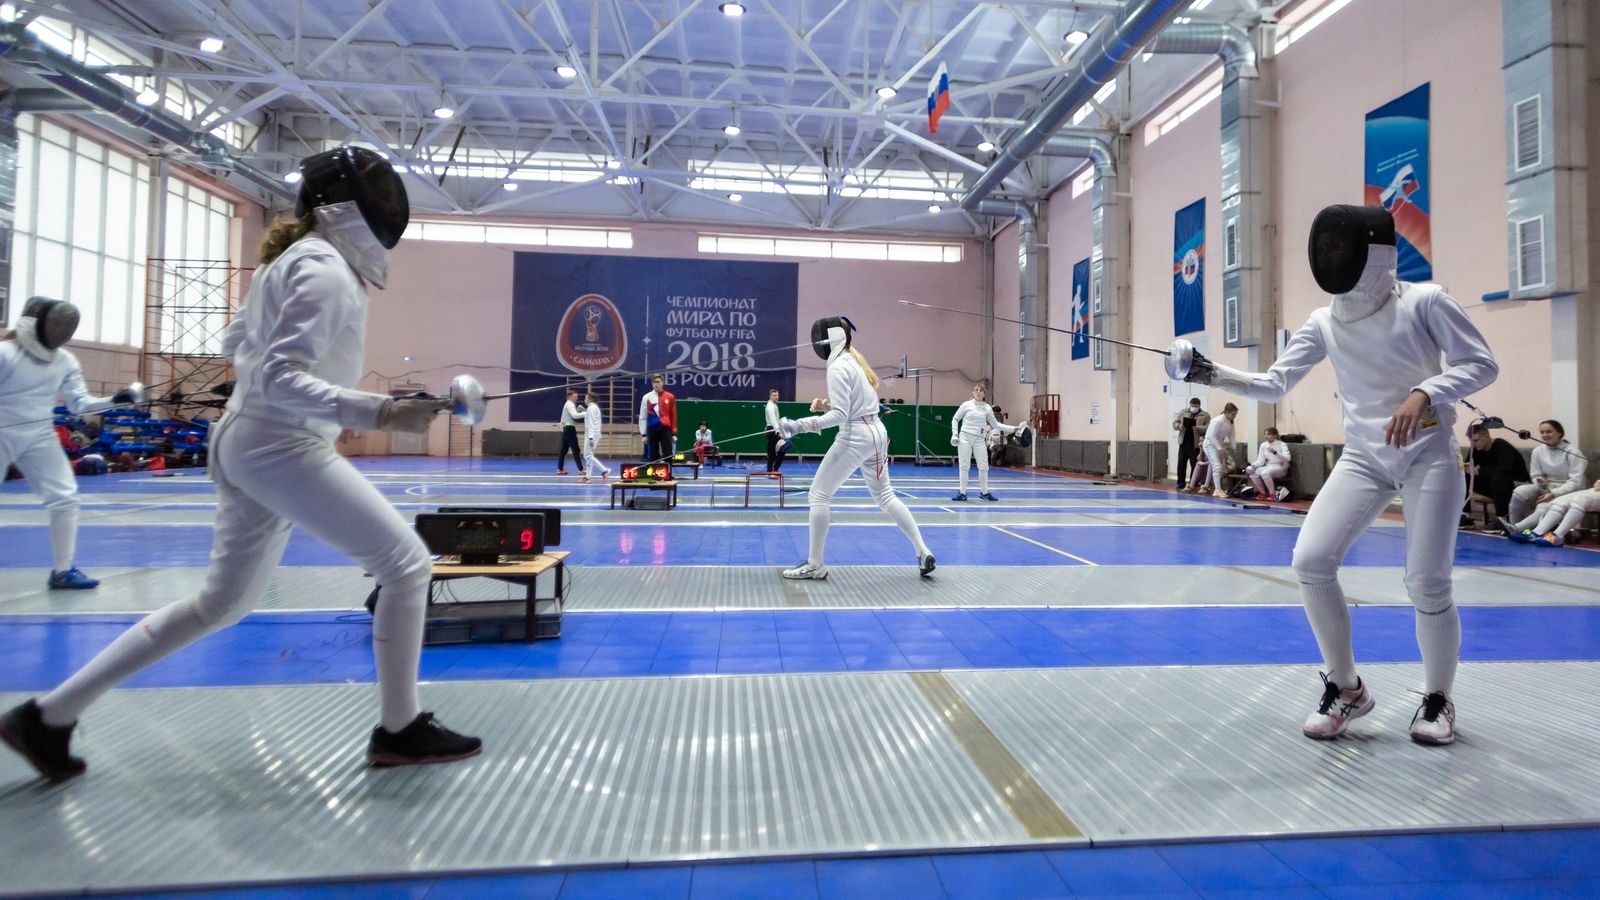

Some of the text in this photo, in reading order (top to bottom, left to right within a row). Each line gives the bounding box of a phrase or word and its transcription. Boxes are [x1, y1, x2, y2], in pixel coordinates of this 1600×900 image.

[666, 295, 758, 310] ЧЕМПИОНАТ
[666, 310, 757, 327] МИРА ПО
[665, 327, 756, 340] ФУТБОЛУ FIFA
[573, 355, 610, 366] САМАРА
[665, 340, 756, 371] 2018
[664, 372, 756, 388] В РОССИИ
[520, 528, 534, 550] 9
